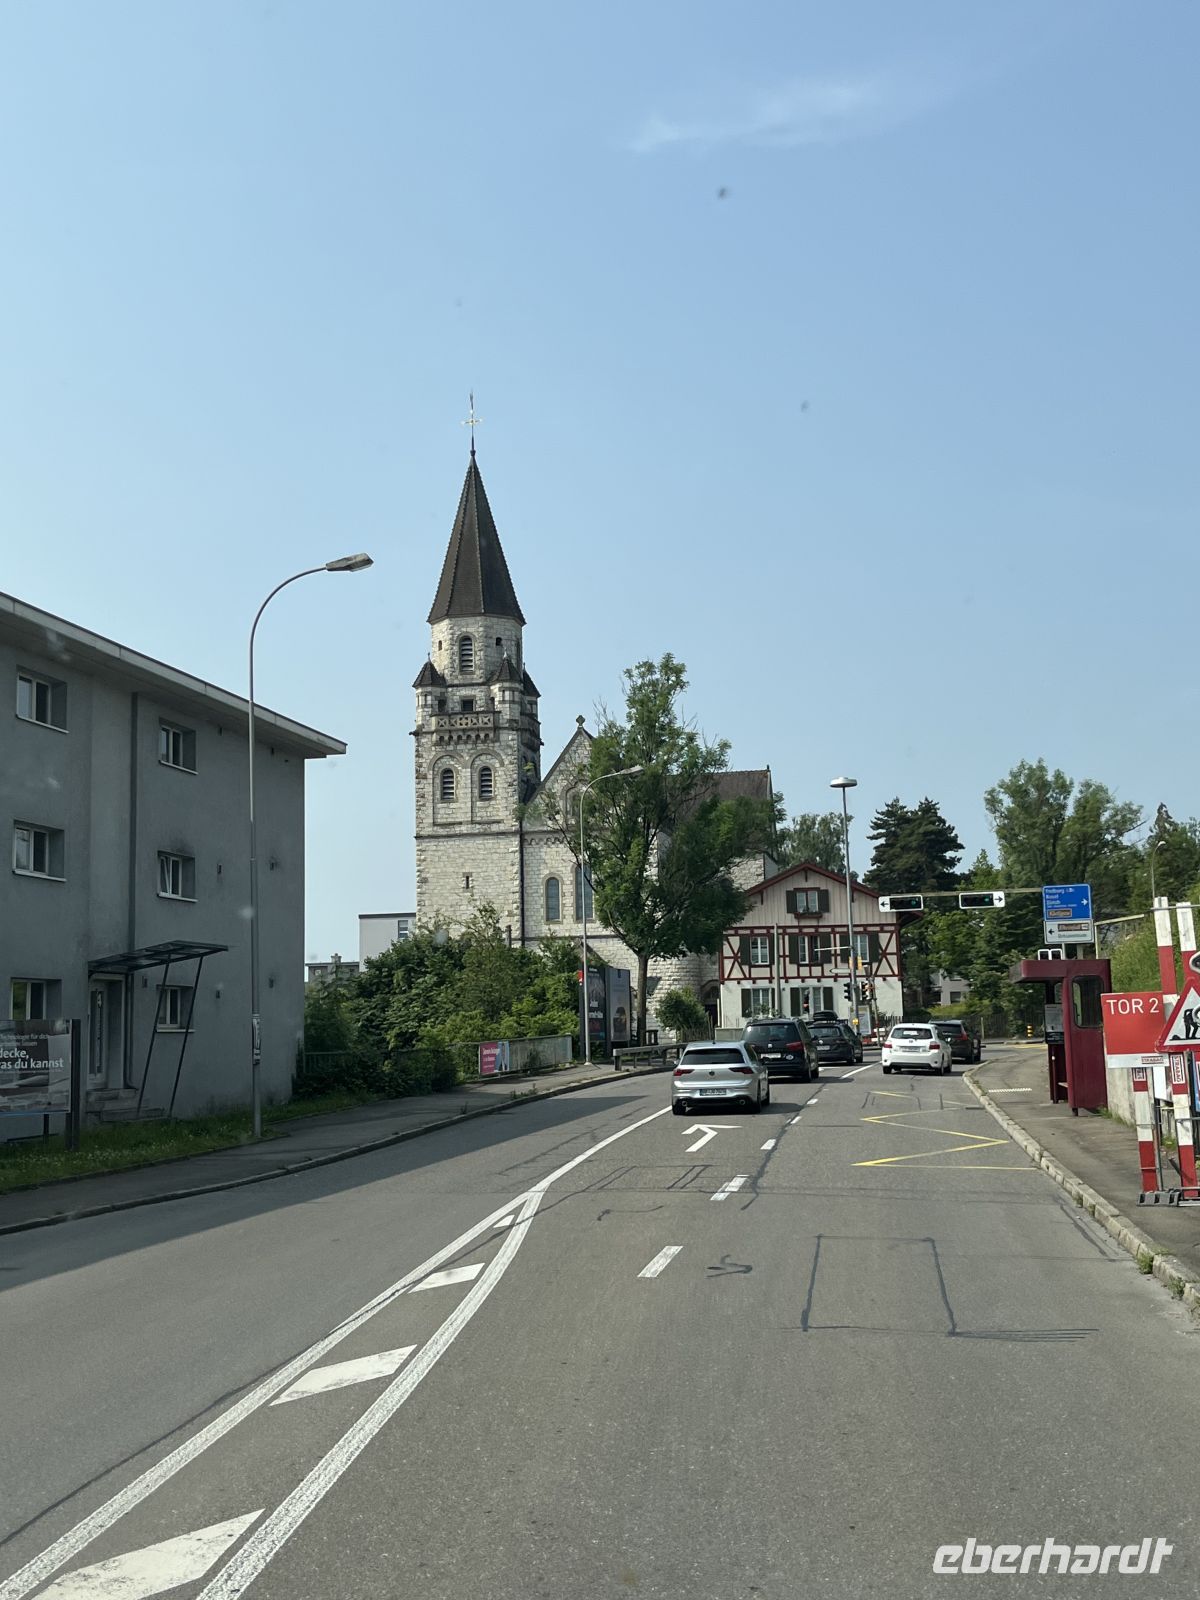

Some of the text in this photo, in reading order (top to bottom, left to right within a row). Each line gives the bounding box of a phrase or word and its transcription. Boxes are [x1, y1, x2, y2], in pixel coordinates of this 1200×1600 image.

[1106, 997, 1160, 1015] TOR 2
[15, 1058, 28, 1069] du
[31, 1057, 64, 1069] kannst
